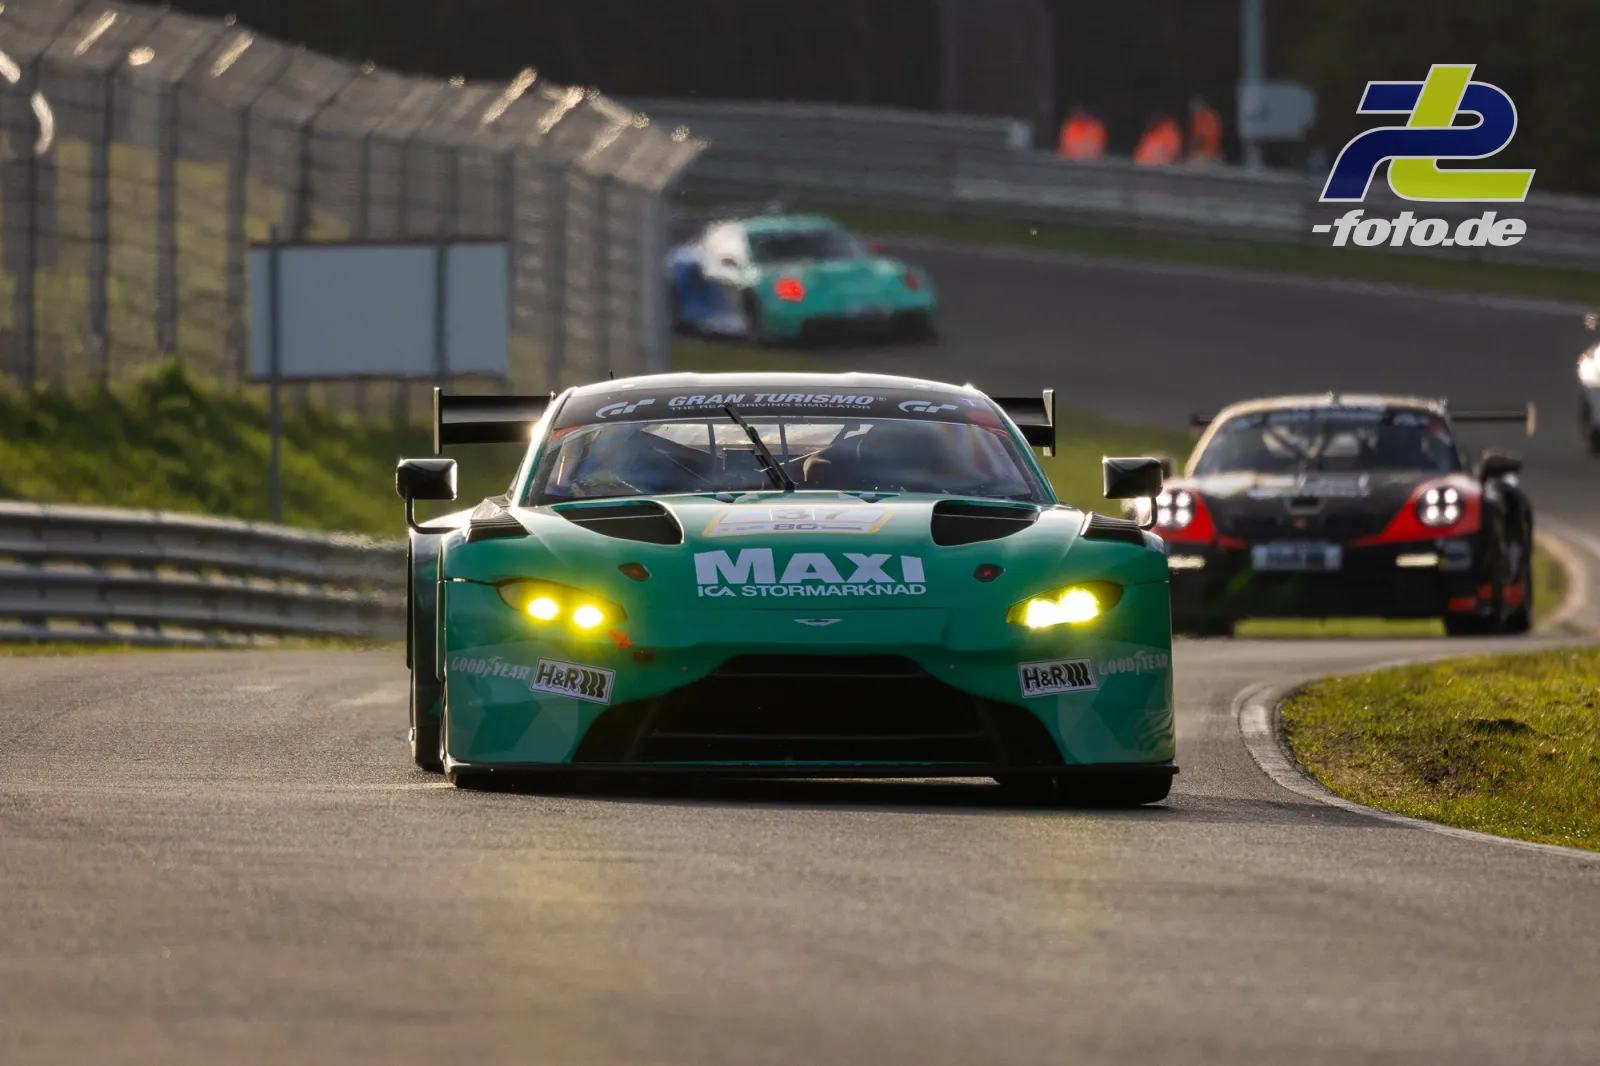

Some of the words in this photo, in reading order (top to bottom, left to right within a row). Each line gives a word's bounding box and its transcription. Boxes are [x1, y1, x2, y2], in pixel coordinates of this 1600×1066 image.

[668, 393, 746, 406] GRAN
[795, 402, 871, 410] SIMULATOR
[693, 548, 926, 585] MAXI
[698, 585, 736, 597] ICA
[741, 584, 927, 597] STORMARKNAD
[451, 656, 530, 680] GOODYEAR
[1099, 650, 1169, 676] GOODYEAR
